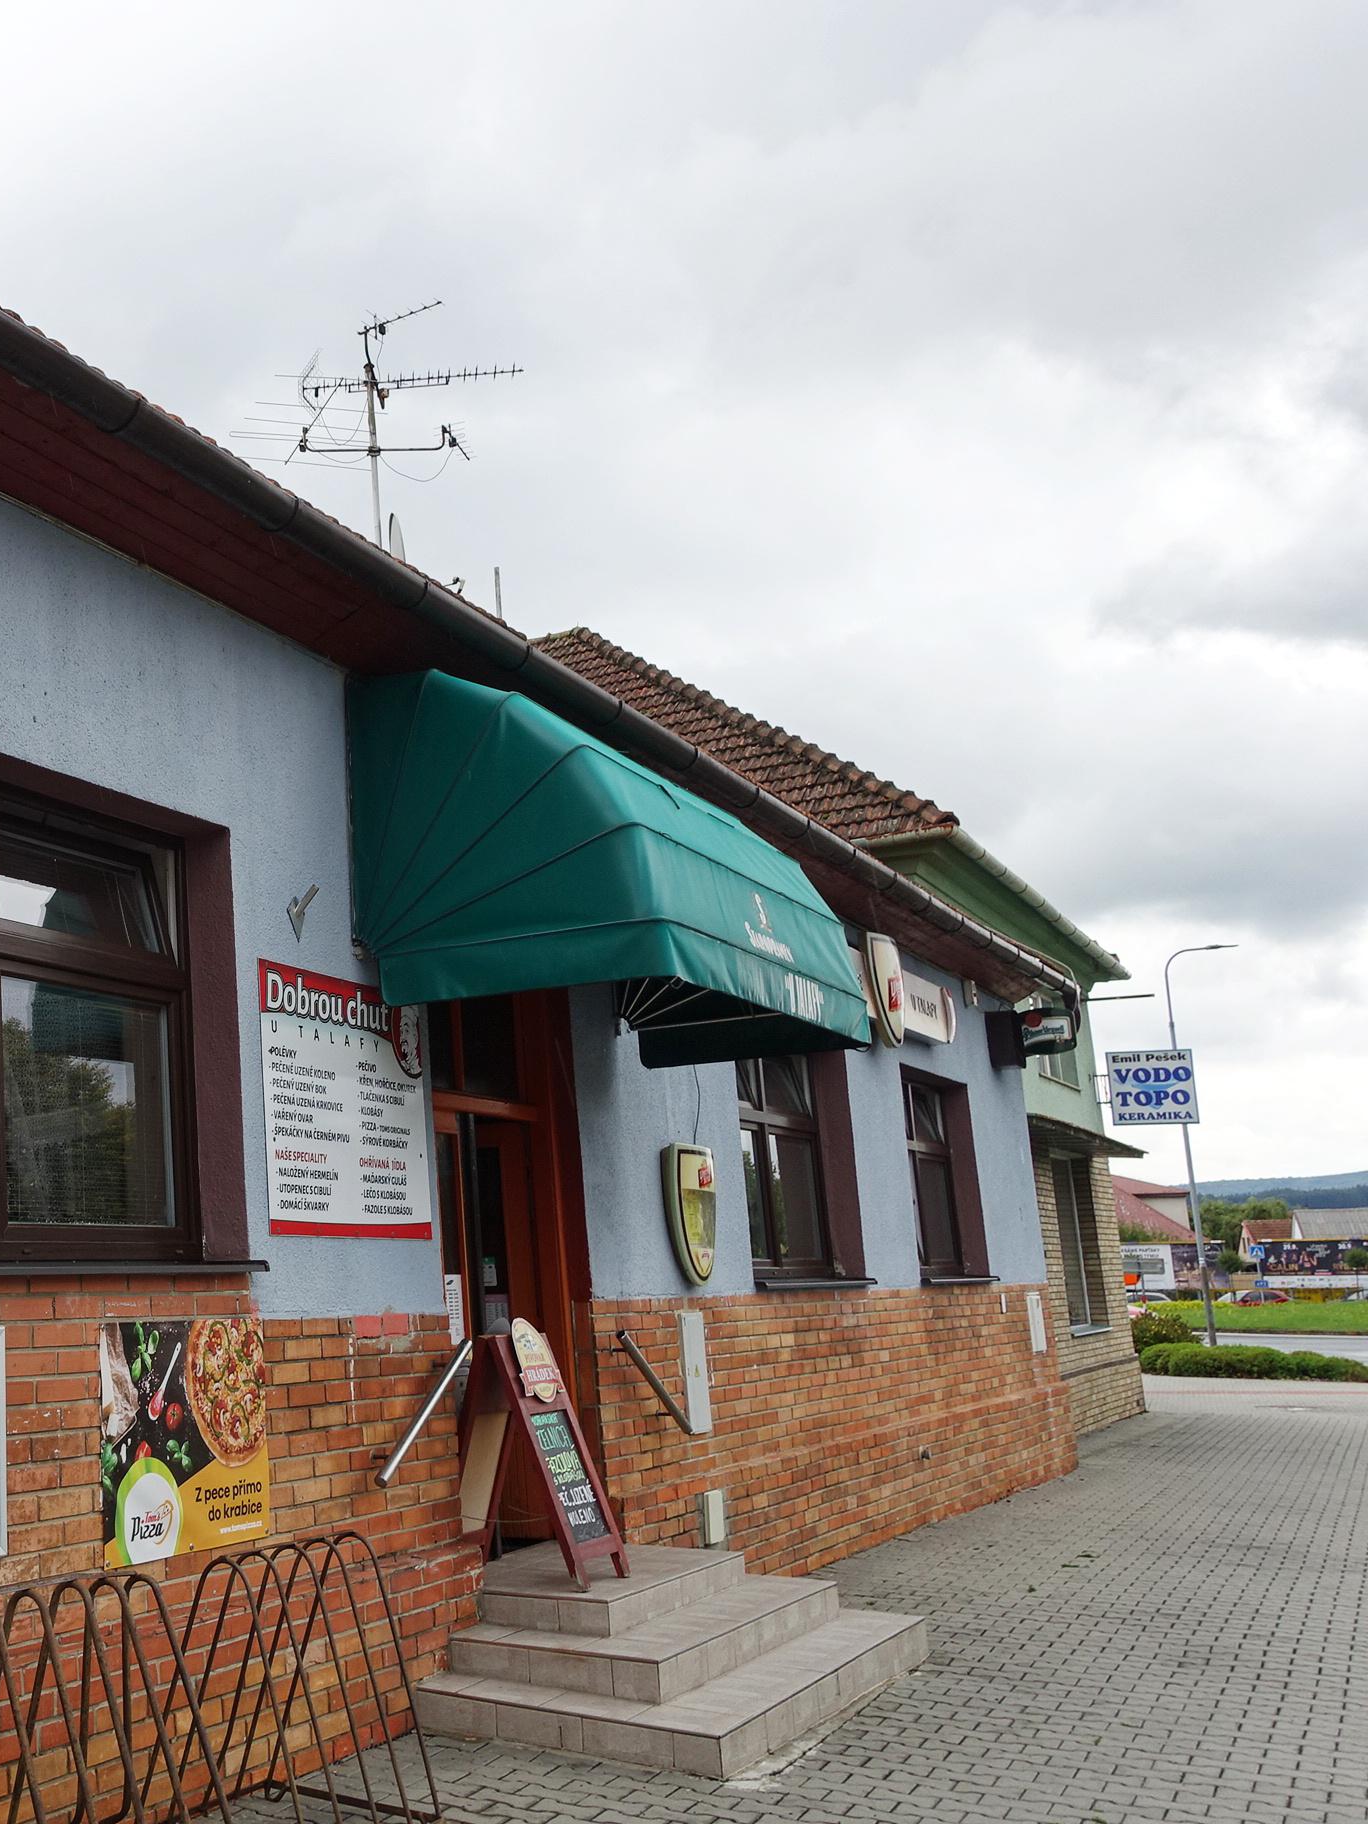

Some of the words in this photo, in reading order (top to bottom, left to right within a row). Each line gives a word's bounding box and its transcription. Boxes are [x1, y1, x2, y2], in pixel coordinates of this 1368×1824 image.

[266, 969, 344, 1027] Dobrou
[271, 1020, 278, 1033] U
[1112, 1053, 1141, 1063] Emil
[1145, 1052, 1187, 1062] Pešek
[1113, 1066, 1192, 1084] VODO
[315, 1084, 327, 1095] BOK
[1115, 1089, 1190, 1107] TOPO
[1118, 1111, 1193, 1121] KERAMIKA
[275, 1146, 293, 1161] NAŠE
[292, 1151, 328, 1165] SPECIALITY
[309, 1168, 339, 1181] HERMELÍN
[303, 1198, 330, 1211] ŠKVARKY
[195, 1487, 203, 1502] Z
[204, 1487, 231, 1504] pece
[232, 1478, 262, 1501] přímo
[208, 1505, 222, 1522] do
[223, 1499, 263, 1519] krabice
